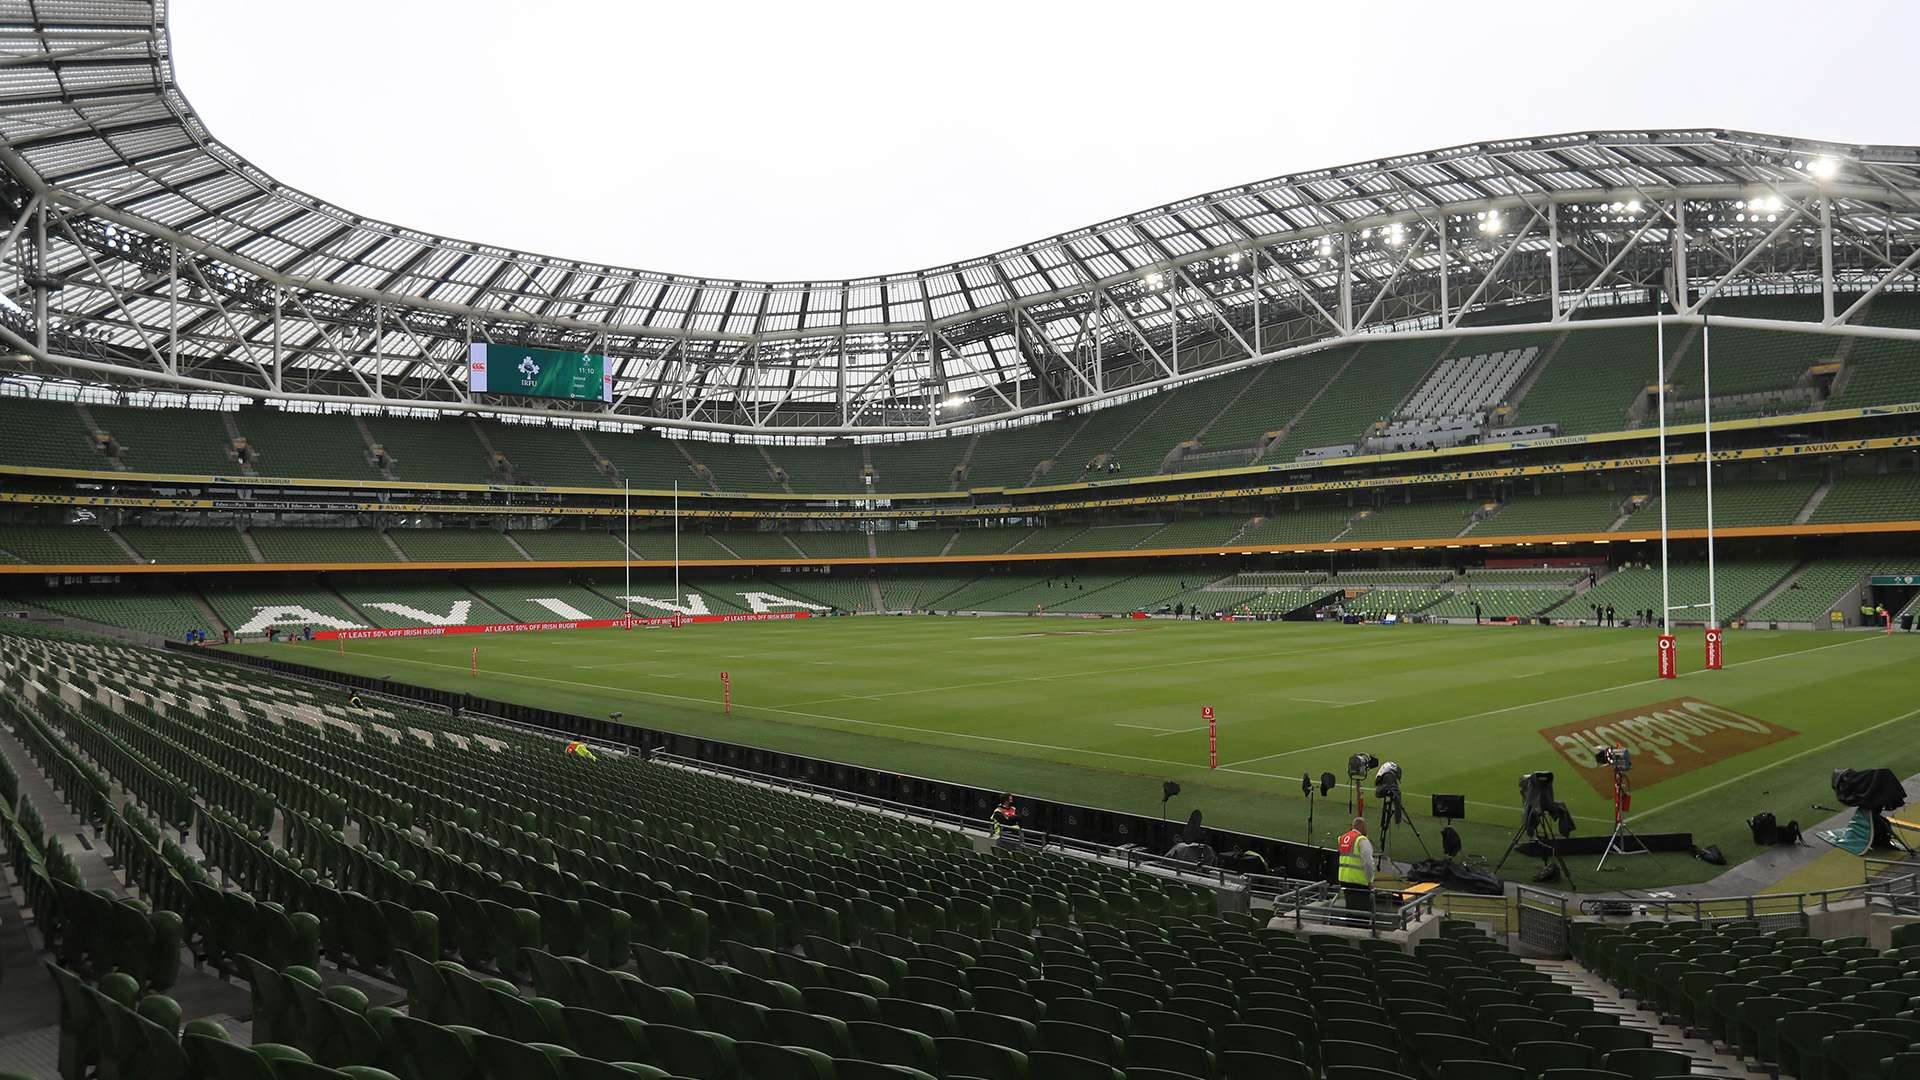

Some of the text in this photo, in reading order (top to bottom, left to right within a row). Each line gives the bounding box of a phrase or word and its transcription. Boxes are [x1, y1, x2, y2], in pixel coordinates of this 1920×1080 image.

[1534, 436, 1587, 448] AVIVA STADIUM
[1804, 443, 1840, 453] AVIVA
[1622, 458, 1651, 467] AVIVA
[1475, 470, 1499, 478] AVIVA
[114, 498, 143, 506] AVIVA
[234, 592, 832, 633] AVIVA
[515, 624, 528, 632] 50%
[558, 622, 578, 630] RUGBY
[338, 632, 347, 640] AT
[348, 631, 371, 639] LEAST
[373, 630, 388, 638] 50%
[403, 629, 422, 637] IRISH
